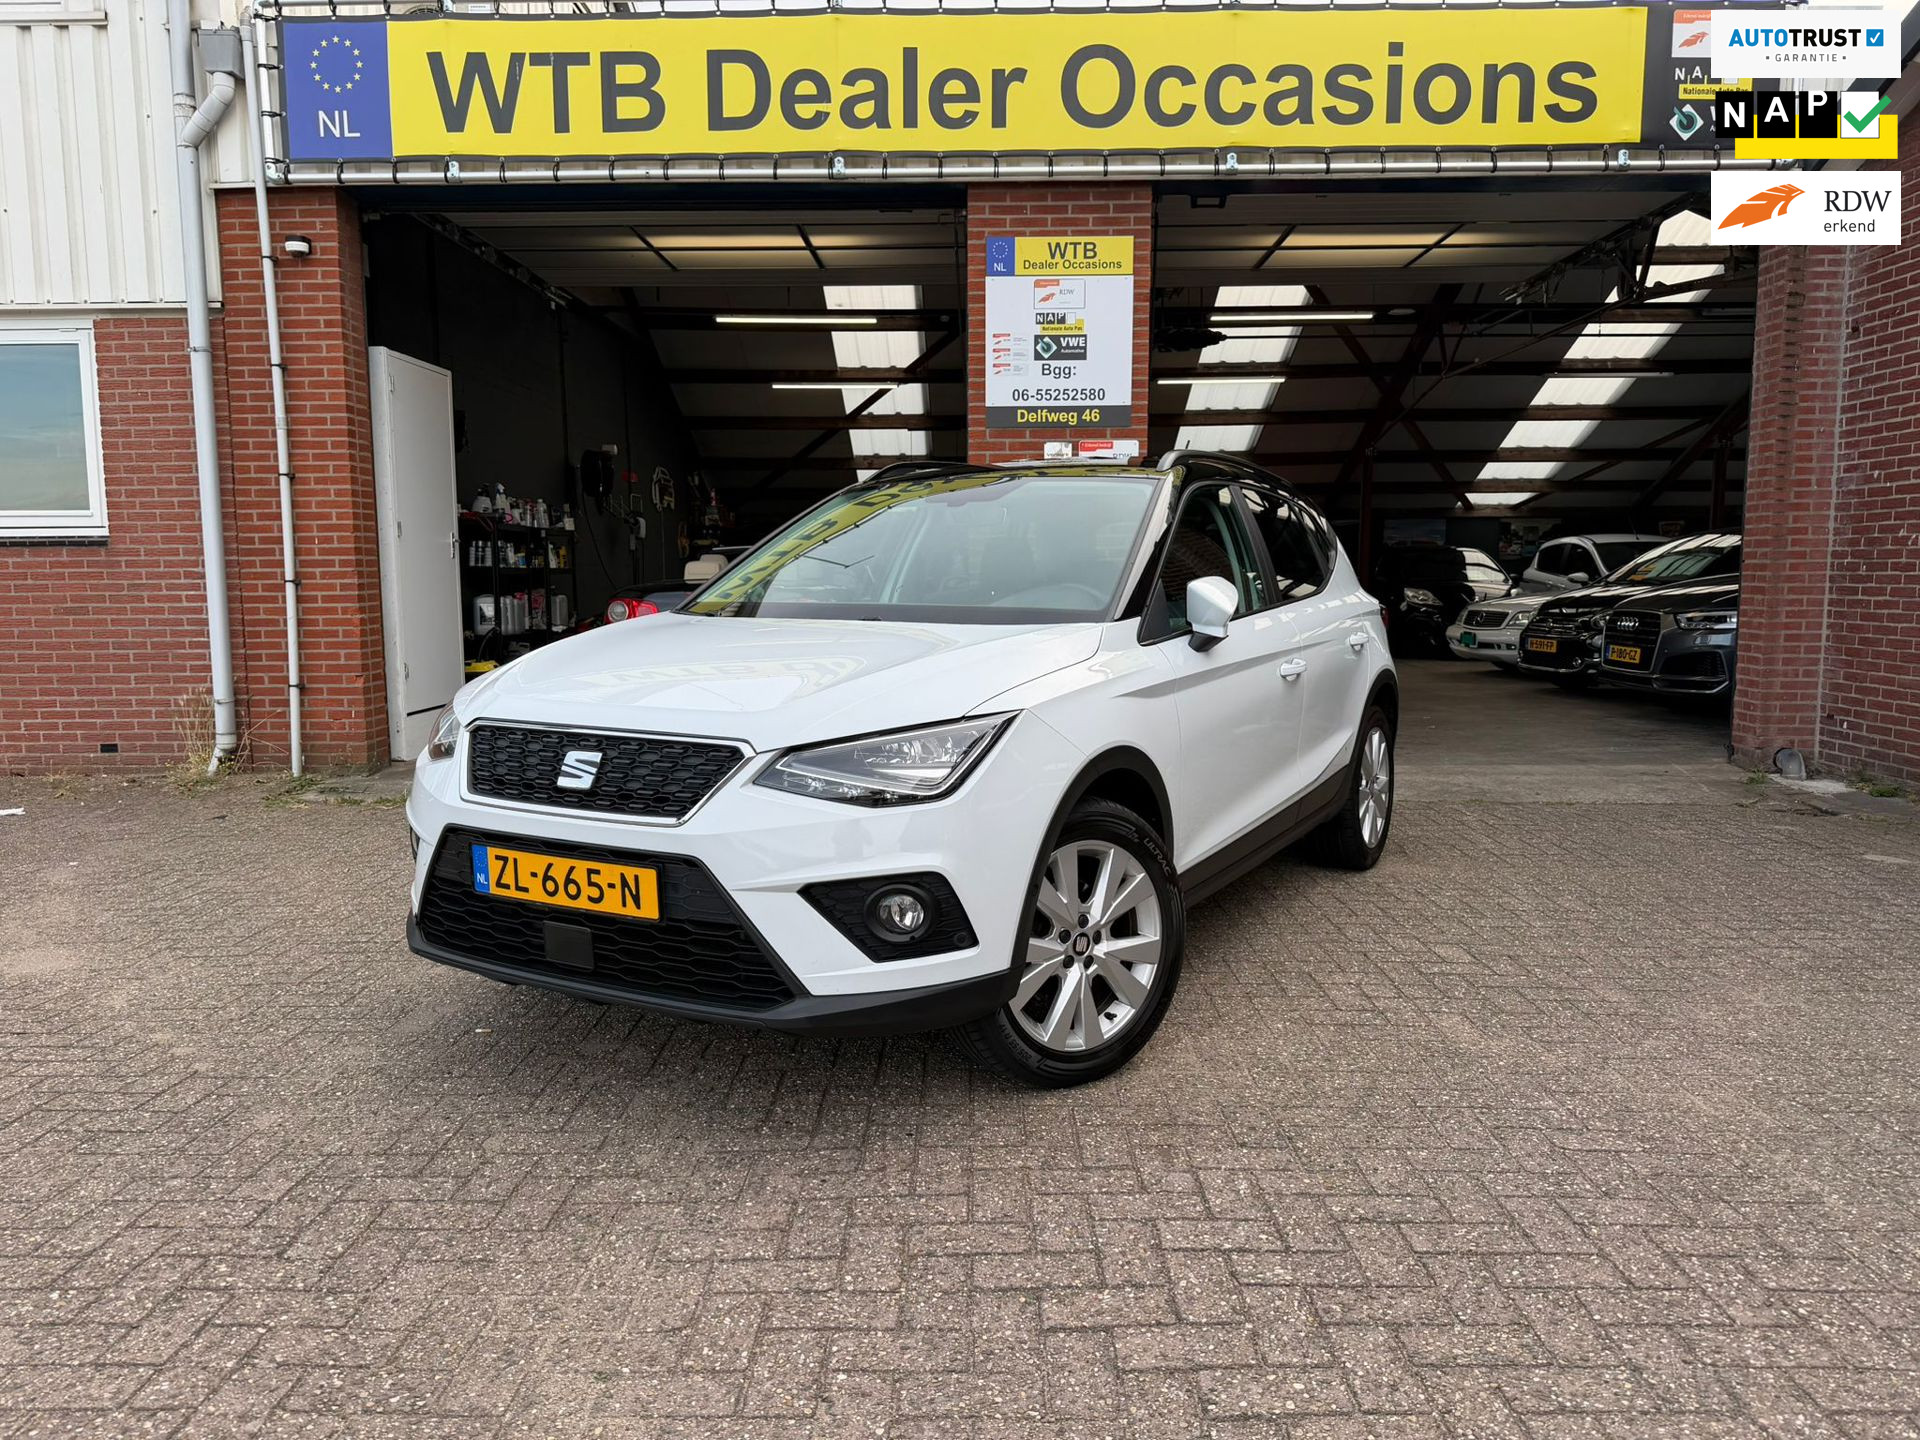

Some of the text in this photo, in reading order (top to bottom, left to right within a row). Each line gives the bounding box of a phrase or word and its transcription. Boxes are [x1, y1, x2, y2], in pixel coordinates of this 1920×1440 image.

[1675, 66, 1703, 80] NA
[427, 42, 1597, 133] WTB Dealer Occasions
[318, 110, 360, 137] NL
[1048, 242, 1097, 259] WTB
[993, 263, 1007, 272] NL
[1023, 259, 1122, 270] Dealer Occasions
[1036, 312, 1065, 323] NAP
[1060, 337, 1086, 347] VWE
[1042, 364, 1076, 379] Bgg:
[1012, 388, 1106, 402] 06-55252580
[1017, 409, 1100, 424] Delfweg 46
[1143, 838, 1172, 876] ULTRAC
[476, 871, 488, 885] NL
[494, 854, 642, 910] ZL-665-N
